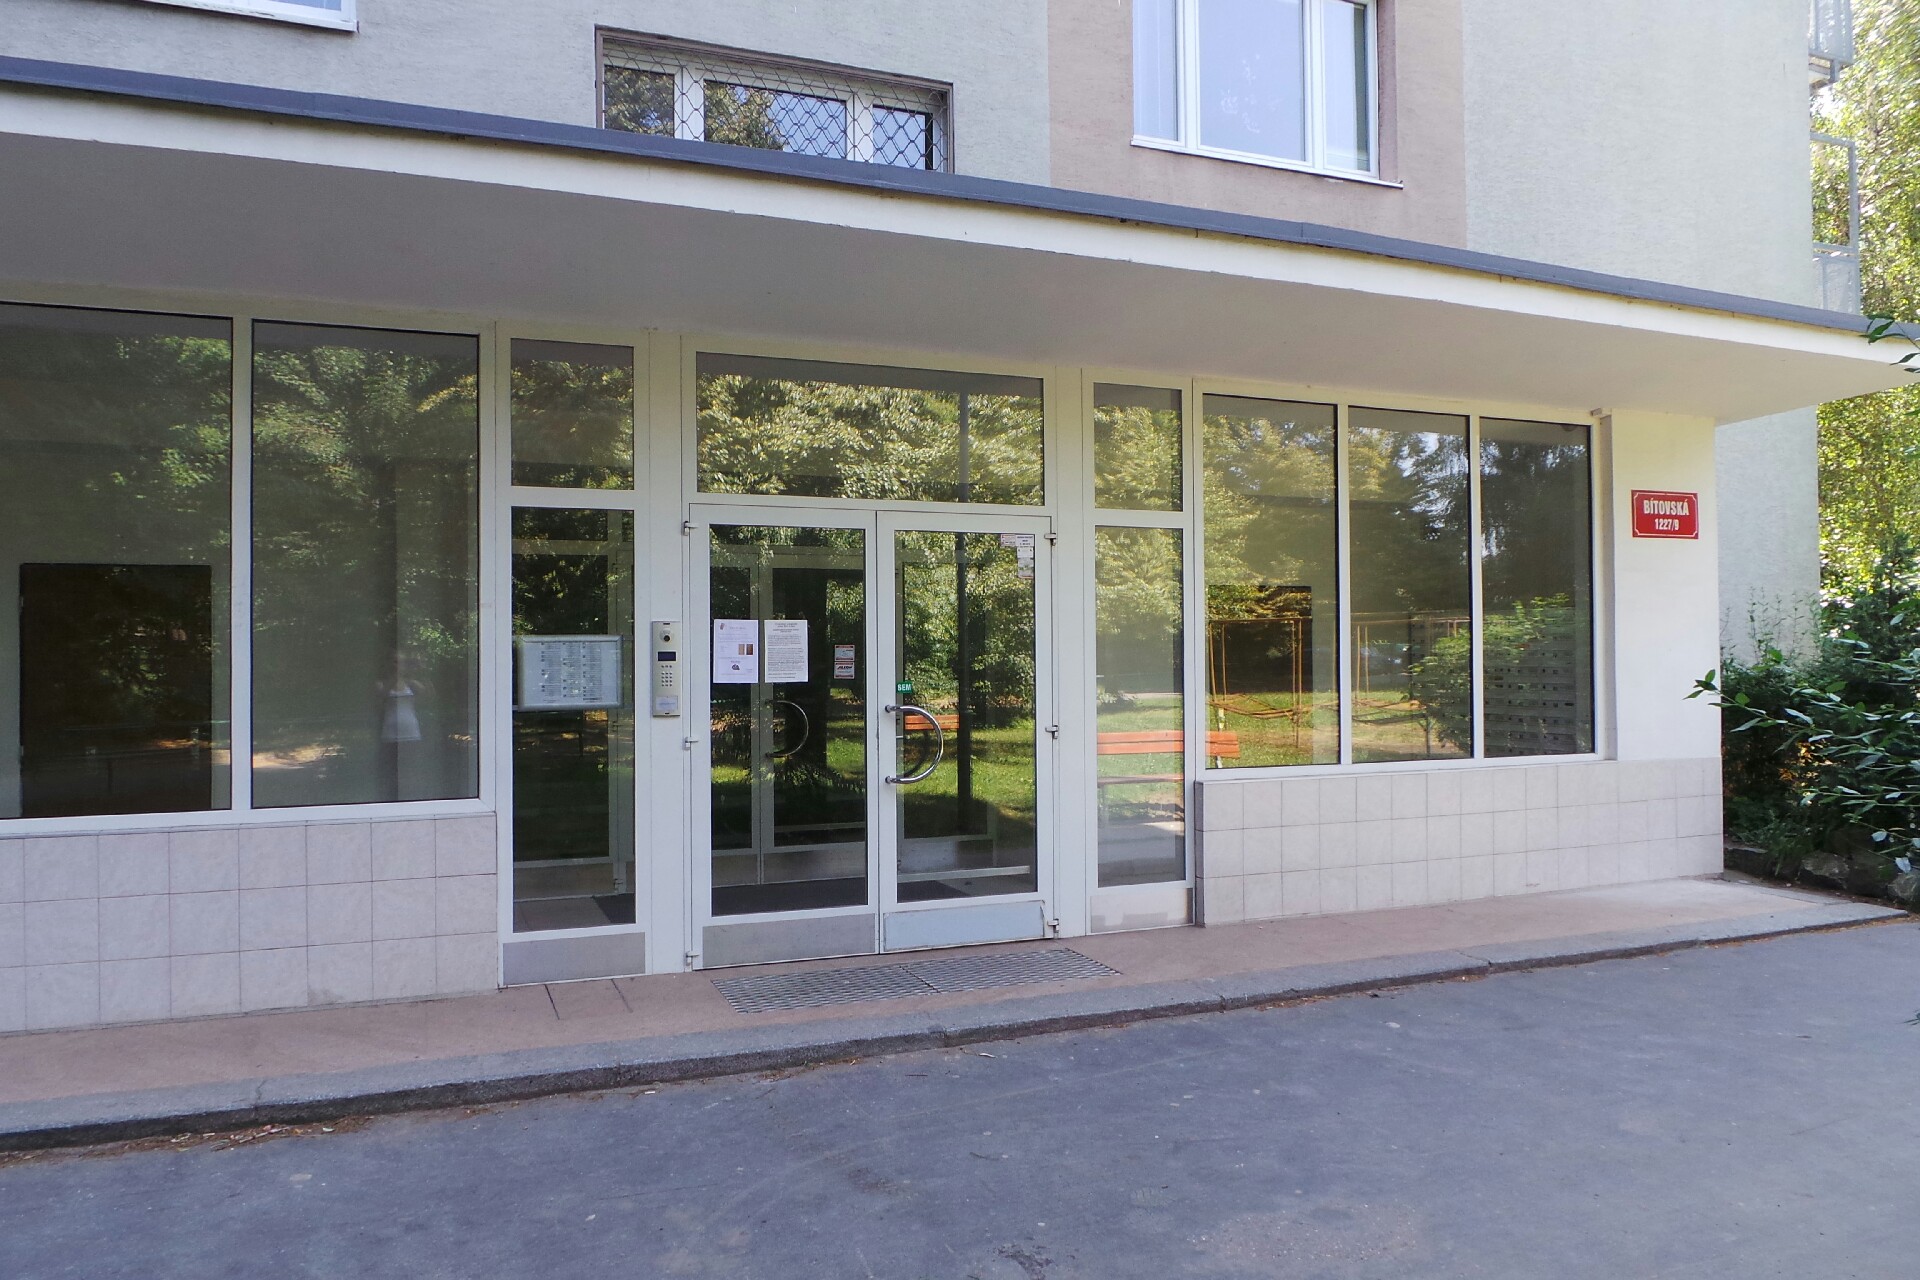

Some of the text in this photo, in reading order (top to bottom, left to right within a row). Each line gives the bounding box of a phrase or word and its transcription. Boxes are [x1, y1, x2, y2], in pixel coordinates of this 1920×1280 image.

[1643, 498, 1689, 515] BÍTOVSKÁ
[1655, 518, 1679, 531] 1227/9
[897, 683, 912, 691] SEM
